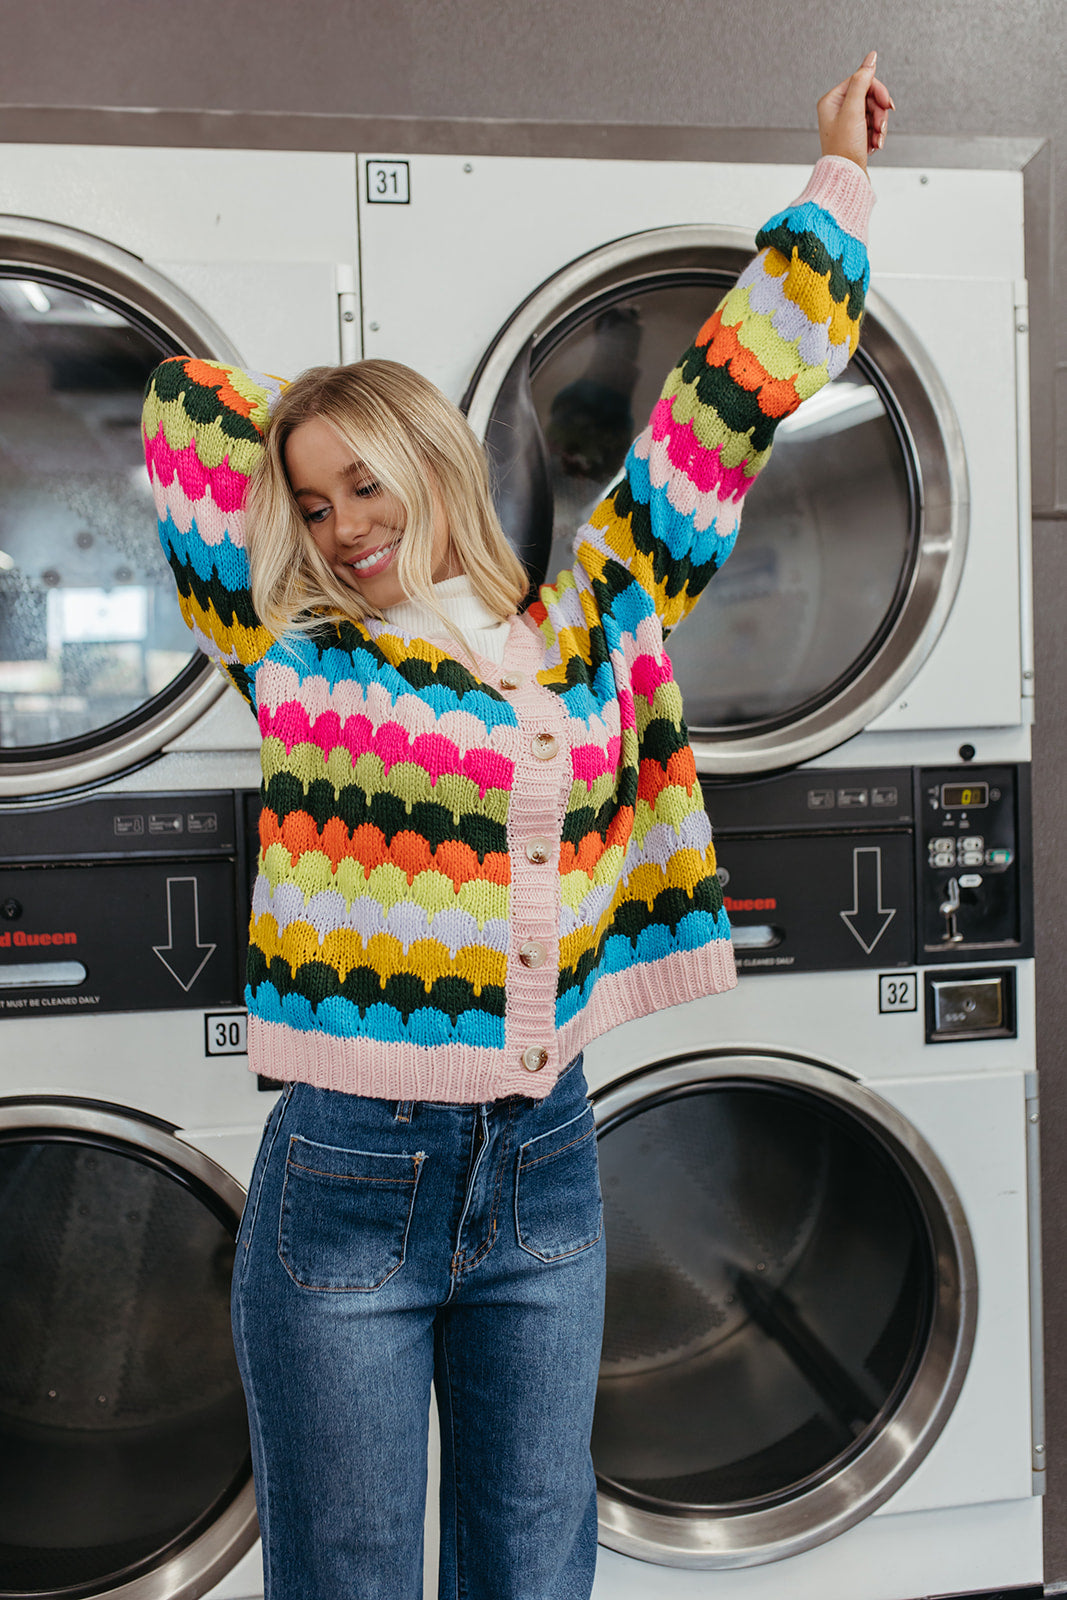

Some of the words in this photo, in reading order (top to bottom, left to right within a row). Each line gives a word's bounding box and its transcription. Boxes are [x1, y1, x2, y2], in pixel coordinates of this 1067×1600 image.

[377, 170, 397, 193] 31
[723, 897, 776, 911] Queen
[13, 931, 77, 946] Queen
[744, 958, 774, 967] CLEANED
[887, 981, 909, 1005] 32
[6, 999, 28, 1008] MUST
[29, 998, 40, 1007] BE
[41, 996, 77, 1006] CLEANED
[79, 995, 100, 1004] DAILY
[215, 1022, 240, 1047] 30
